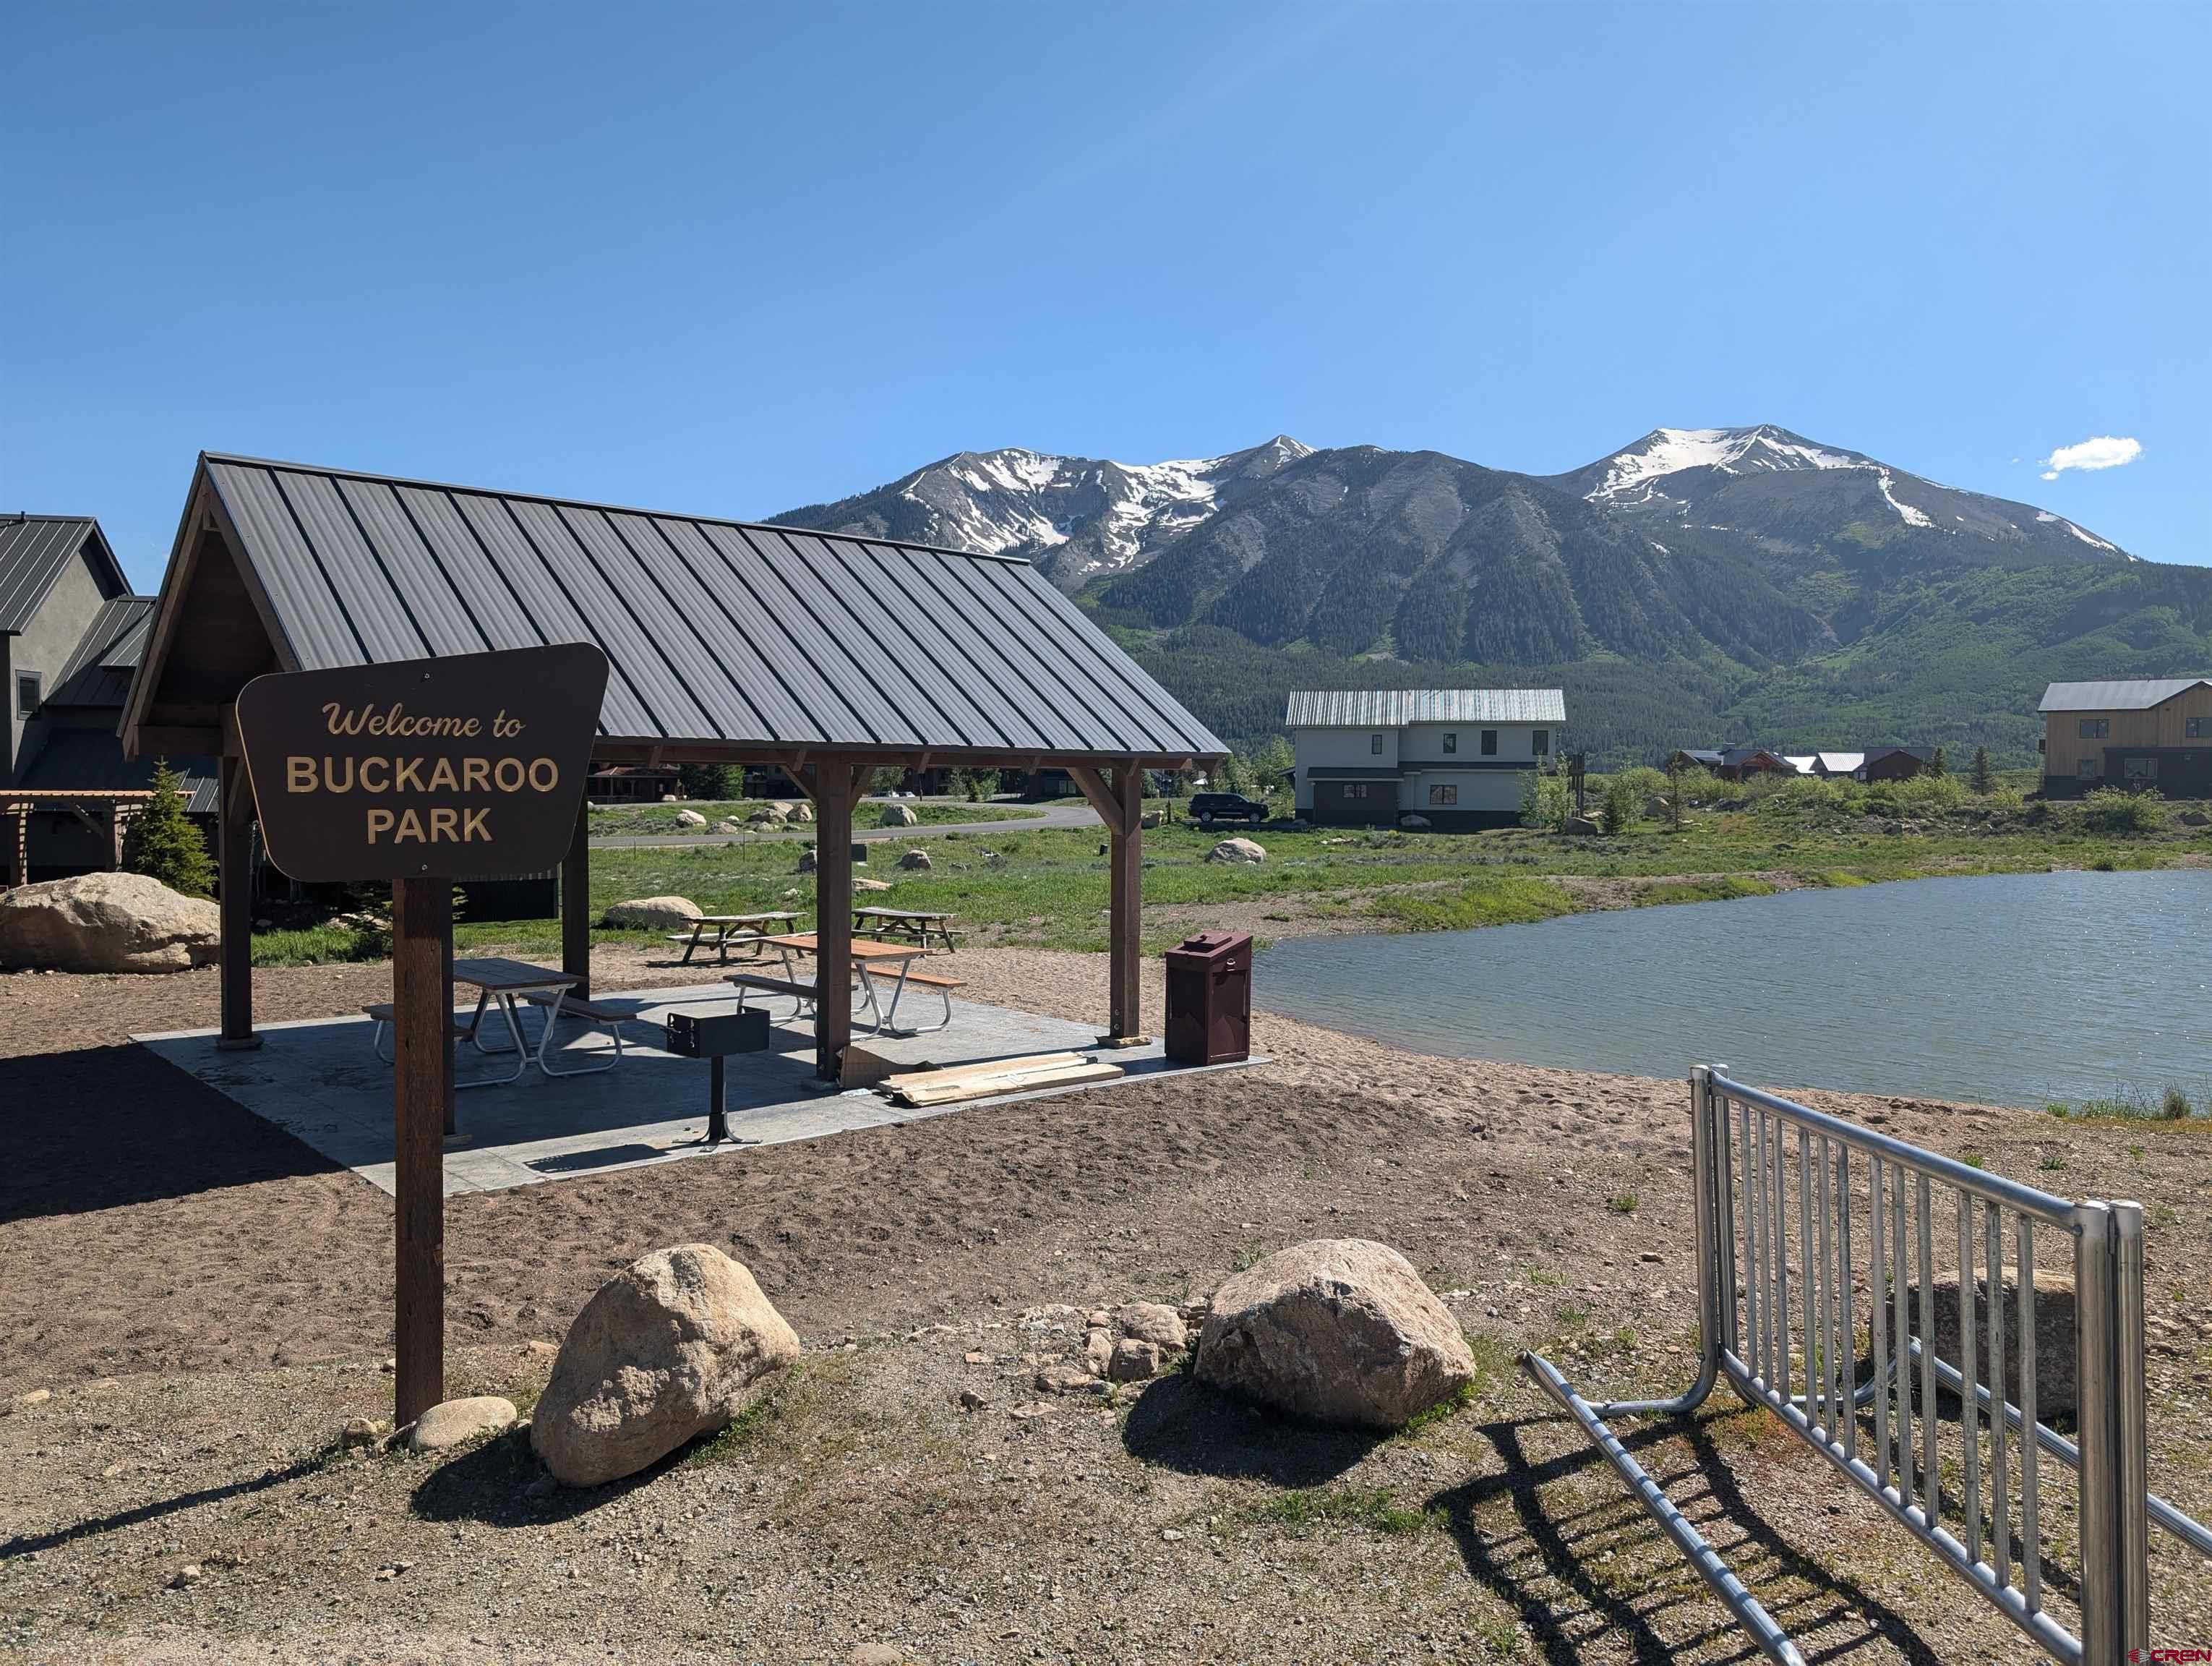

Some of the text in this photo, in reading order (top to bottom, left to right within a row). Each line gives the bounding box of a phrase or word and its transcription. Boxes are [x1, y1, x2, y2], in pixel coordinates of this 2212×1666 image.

[322, 703, 525, 737] Welcome to
[287, 756, 559, 793] BUCKAROO
[366, 808, 492, 844] PARK
